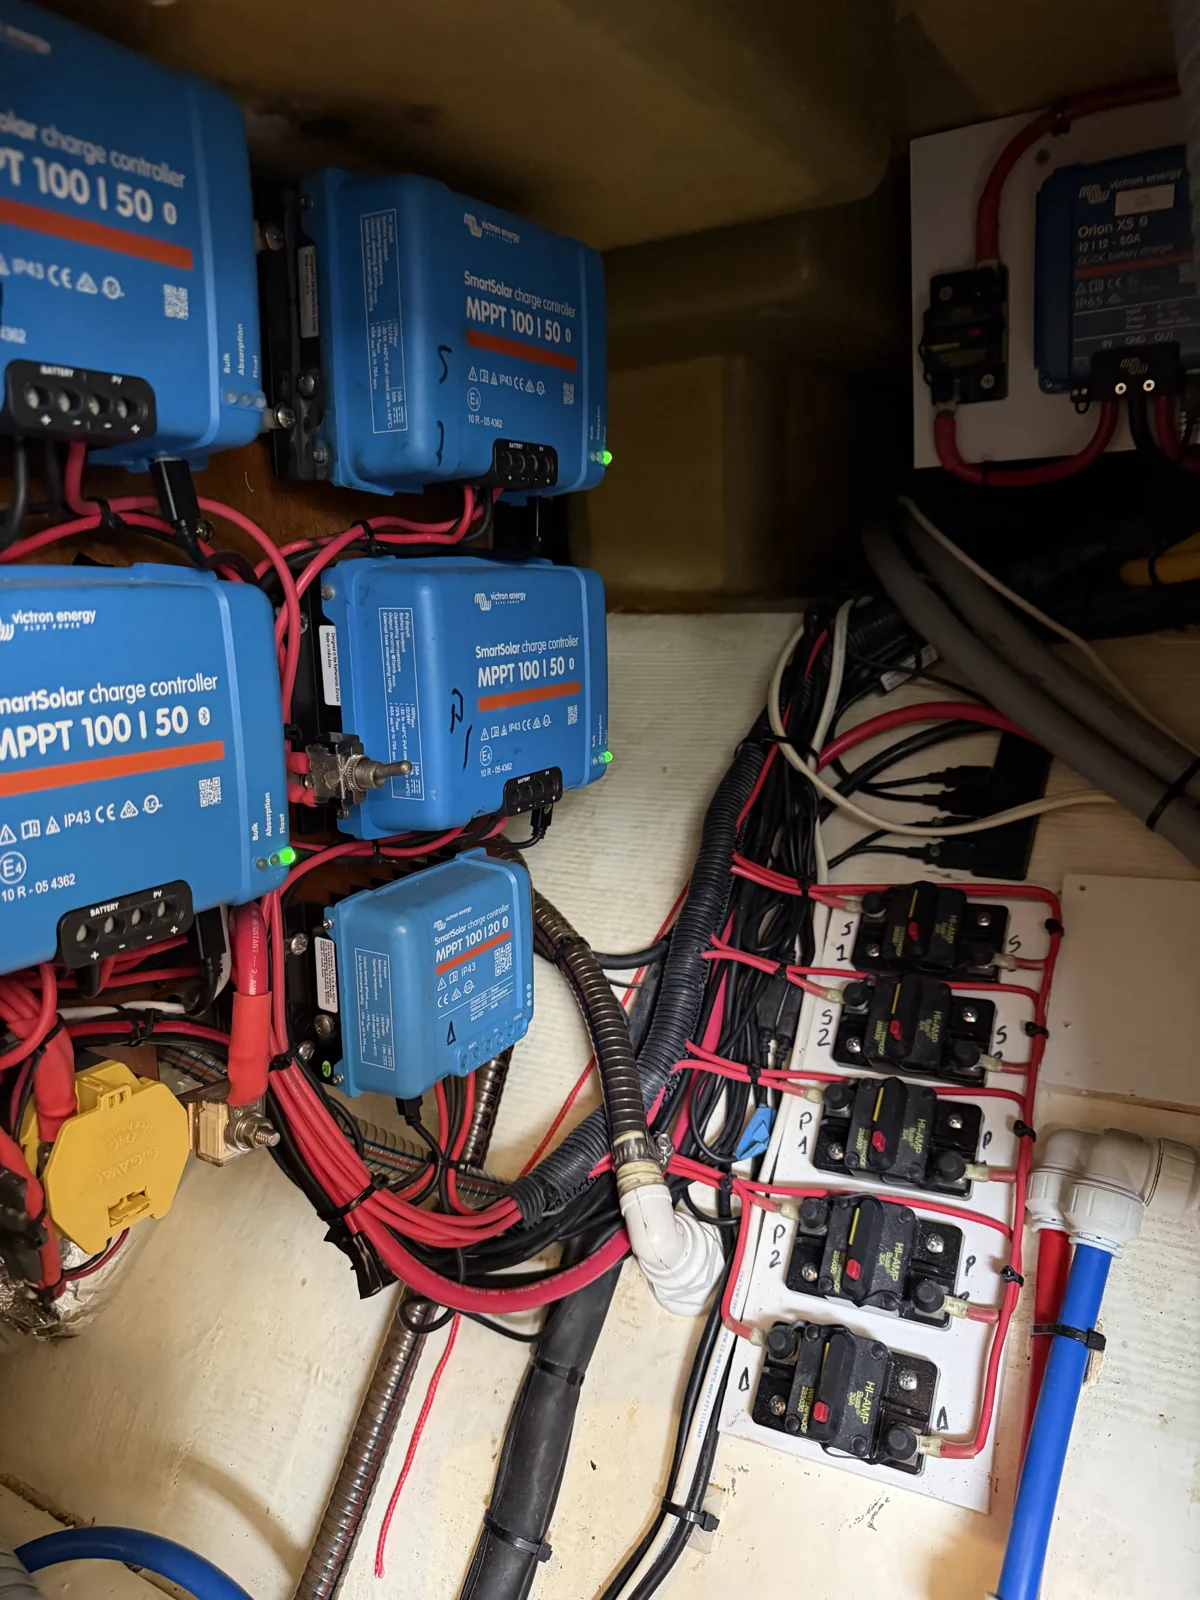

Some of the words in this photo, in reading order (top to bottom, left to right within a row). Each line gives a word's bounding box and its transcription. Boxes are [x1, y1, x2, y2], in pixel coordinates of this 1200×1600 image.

[109, 150, 185, 190] controller
[32, 157, 90, 205] 100
[116, 182, 153, 223] 50
[1078, 223, 1112, 238] Orion
[1099, 239, 1108, 249] 12
[464, 270, 512, 299] SmartSolar
[514, 288, 541, 310] charge
[542, 299, 576, 318] controller
[1076, 296, 1103, 310] IP65
[466, 296, 507, 329] MPPT
[510, 308, 534, 336] 100
[545, 319, 561, 343] 50
[237, 323, 245, 376] Absorption
[1125, 335, 1146, 345] GND
[41, 365, 74, 378] BATTERY
[499, 374, 512, 387] IP43
[12, 610, 54, 624] victron
[56, 610, 96, 624] energy
[476, 642, 520, 659] SmartSolar
[522, 640, 546, 654] charge
[548, 635, 579, 650] controller
[478, 663, 515, 688] MPPT
[518, 660, 540, 681] 100
[550, 656, 564, 676] 50
[90, 682, 146, 704] charge
[150, 673, 218, 697] controller
[81, 713, 132, 748] 100
[156, 706, 188, 736] 50
[508, 721, 521, 733] IP43
[64, 810, 91, 828] IP43
[1, 889, 15, 903] 10
[17, 887, 27, 899] R
[35, 880, 49, 894] 05
[50, 874, 76, 890] 4362
[90, 902, 120, 918] BATTERY
[153, 890, 163, 899] PV
[434, 924, 466, 946] SmartSolar
[468, 916, 486, 930] charge
[486, 904, 510, 920] controller
[436, 938, 463, 964] MPPT
[465, 929, 482, 948] 100
[487, 920, 500, 937] 20
[462, 962, 476, 978] IP43
[817, 1029, 831, 1047] 2
[930, 1010, 942, 1043] HI-AMP
[914, 1118, 927, 1154] HI-AMP
[773, 1224, 786, 1244] P
[768, 1250, 782, 1269] 2
[891, 1242, 905, 1282] HI-AMP
[796, 1385, 807, 1413] 285030
[847, 1391, 856, 1406] 30A
[860, 1380, 876, 1424] HI-AMP
